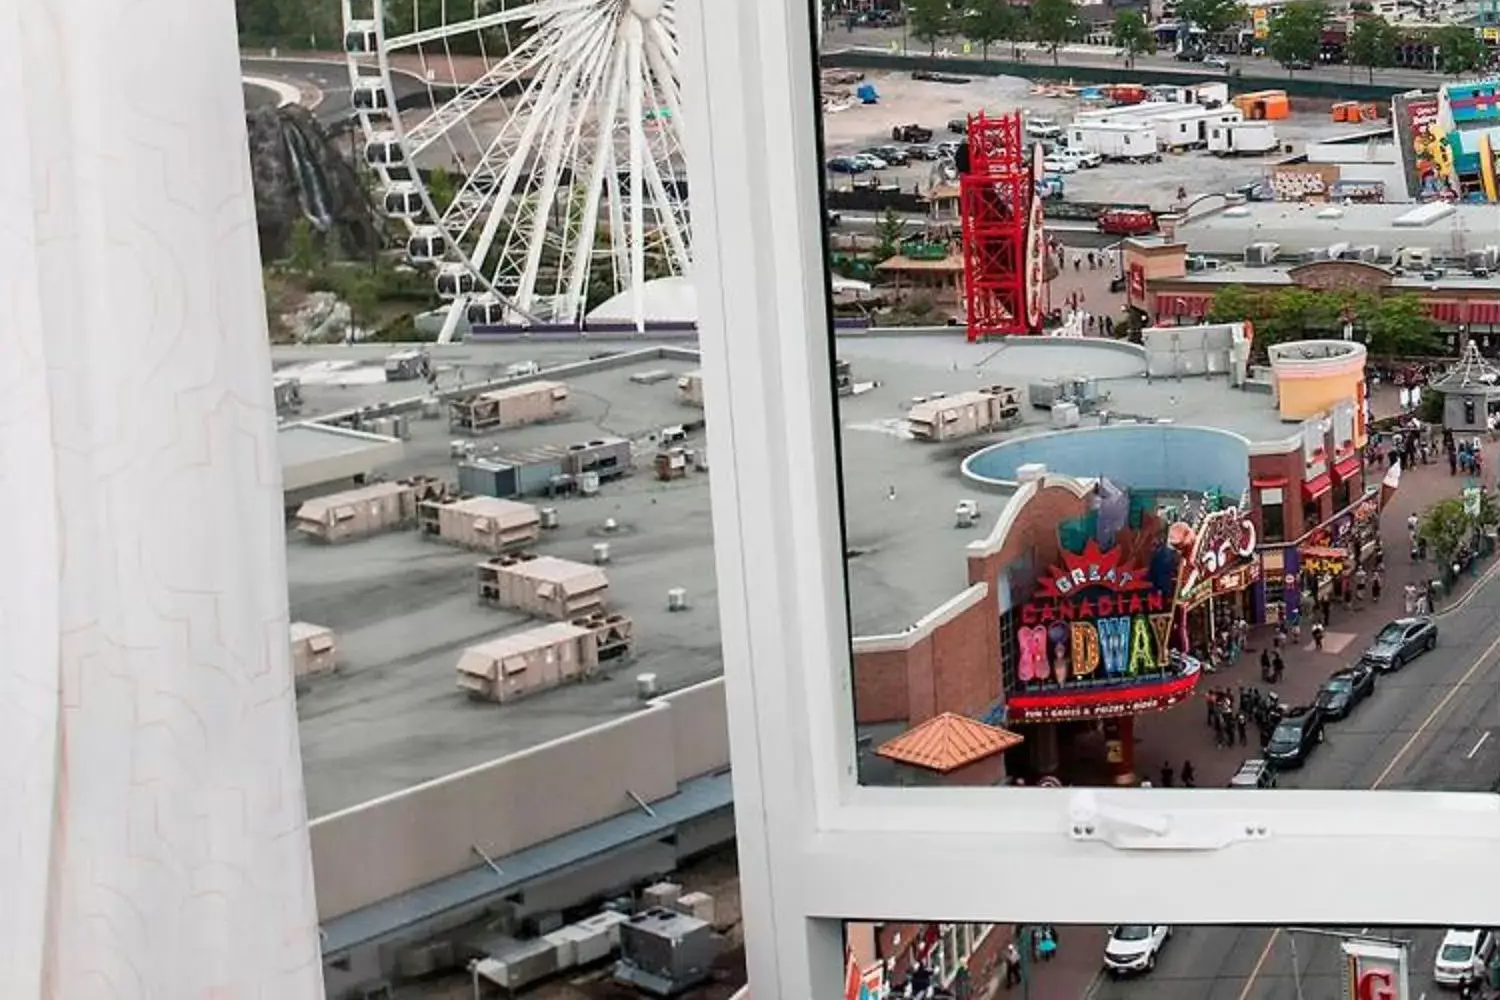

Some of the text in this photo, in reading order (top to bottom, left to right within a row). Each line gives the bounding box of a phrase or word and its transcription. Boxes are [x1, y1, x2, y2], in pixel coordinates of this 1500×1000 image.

[1055, 564, 1133, 594] GREAT
[1022, 590, 1164, 624] CANADIAN
[1051, 707, 1082, 717] GAMES
